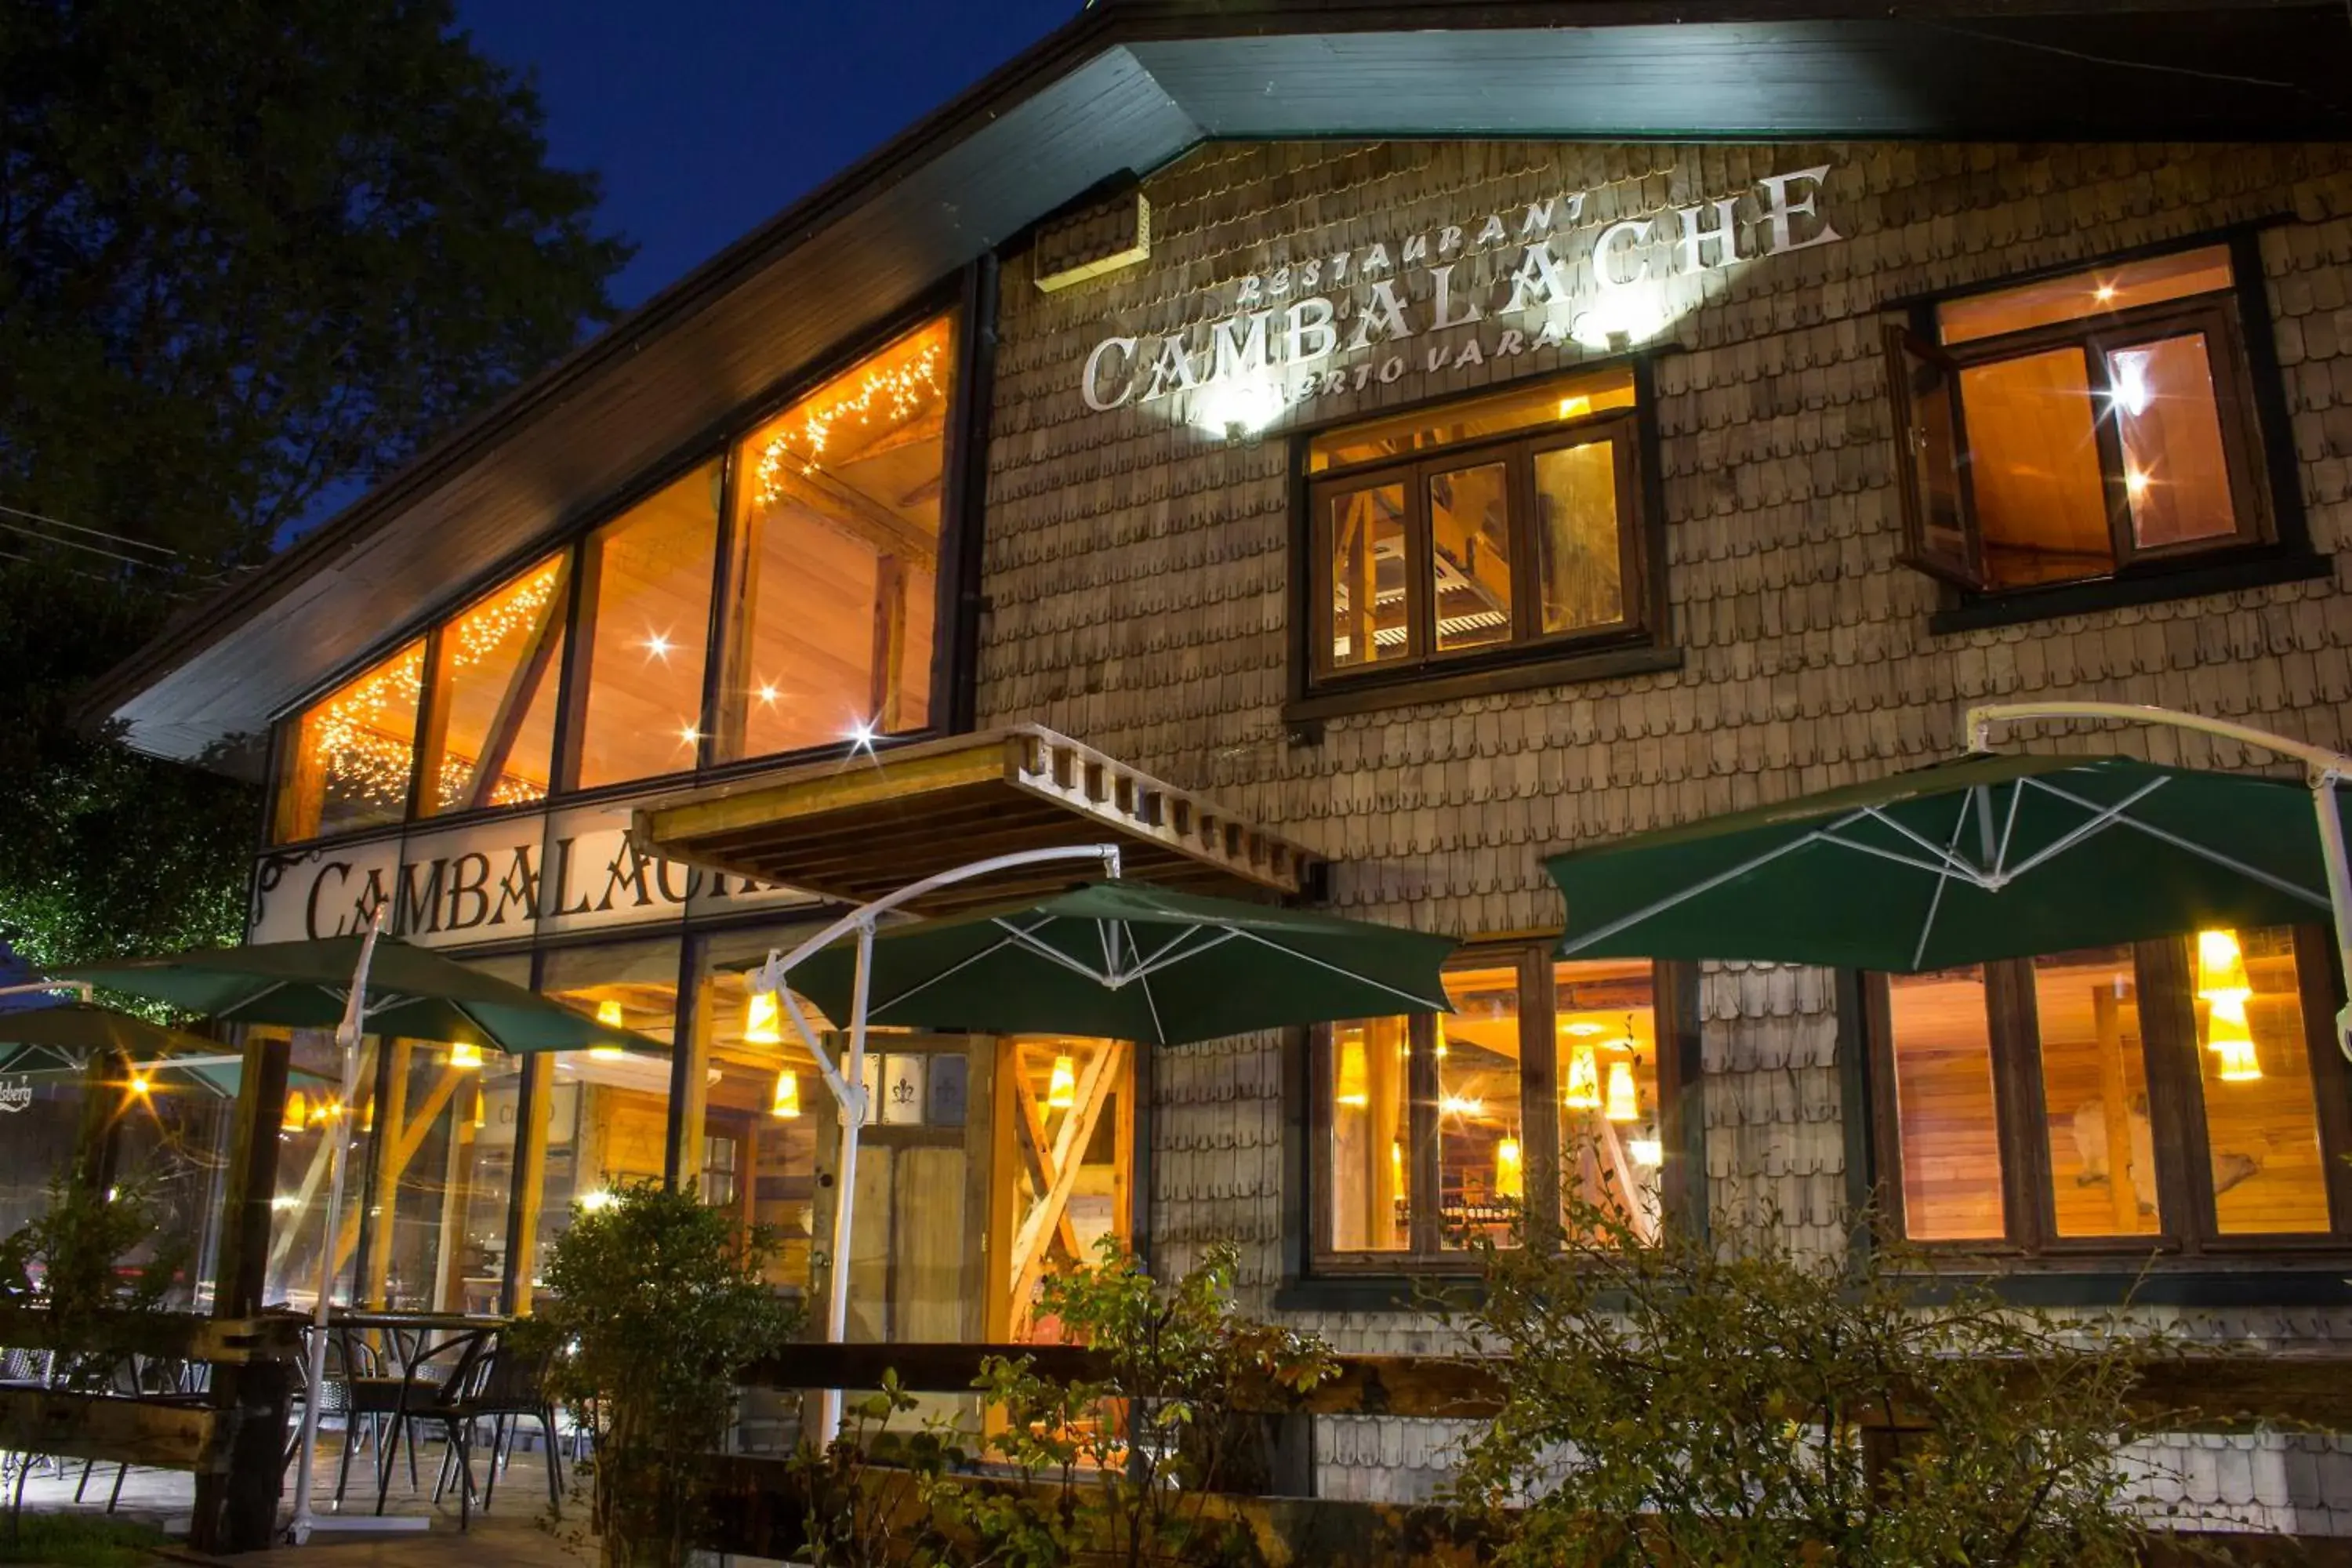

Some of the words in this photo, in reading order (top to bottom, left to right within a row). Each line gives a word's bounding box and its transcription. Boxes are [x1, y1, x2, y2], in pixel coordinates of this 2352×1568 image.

[1081, 164, 1842, 412] CAMBALACHE
[1237, 192, 1587, 303] RESTAURANT
[1232, 356, 1406, 412] ERTO
[306, 829, 785, 938] CAMBALA
